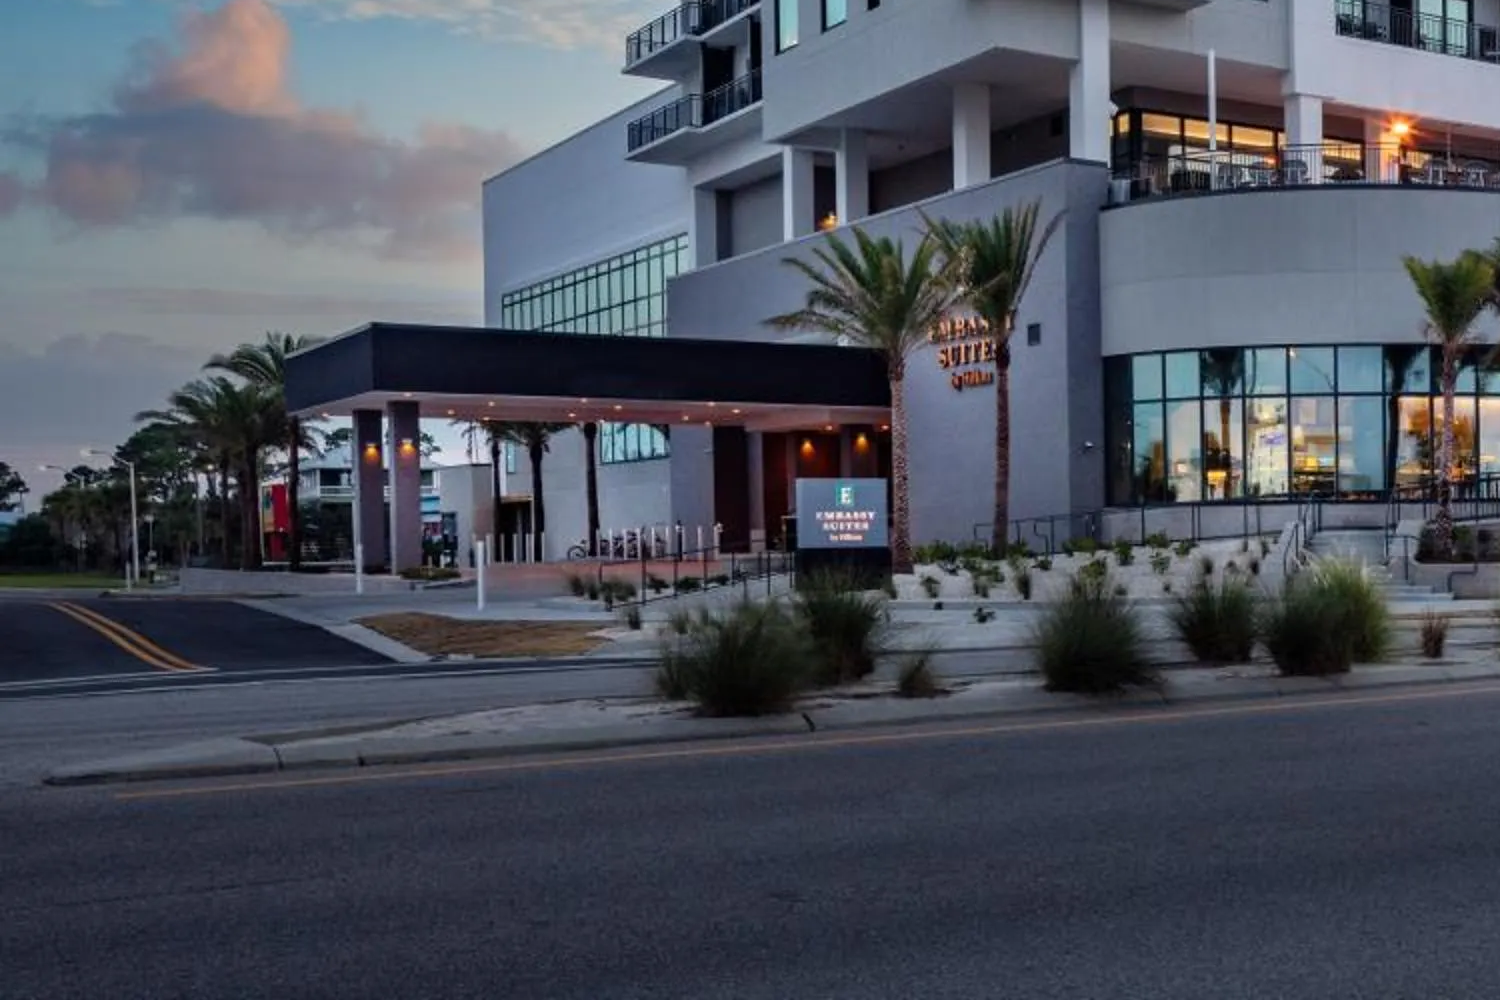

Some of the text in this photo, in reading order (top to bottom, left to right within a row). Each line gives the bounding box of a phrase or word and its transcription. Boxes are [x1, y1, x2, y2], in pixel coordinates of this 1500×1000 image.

[840, 486, 853, 505] E
[815, 511, 877, 521] EMBASSY
[823, 521, 869, 531] SUITES
